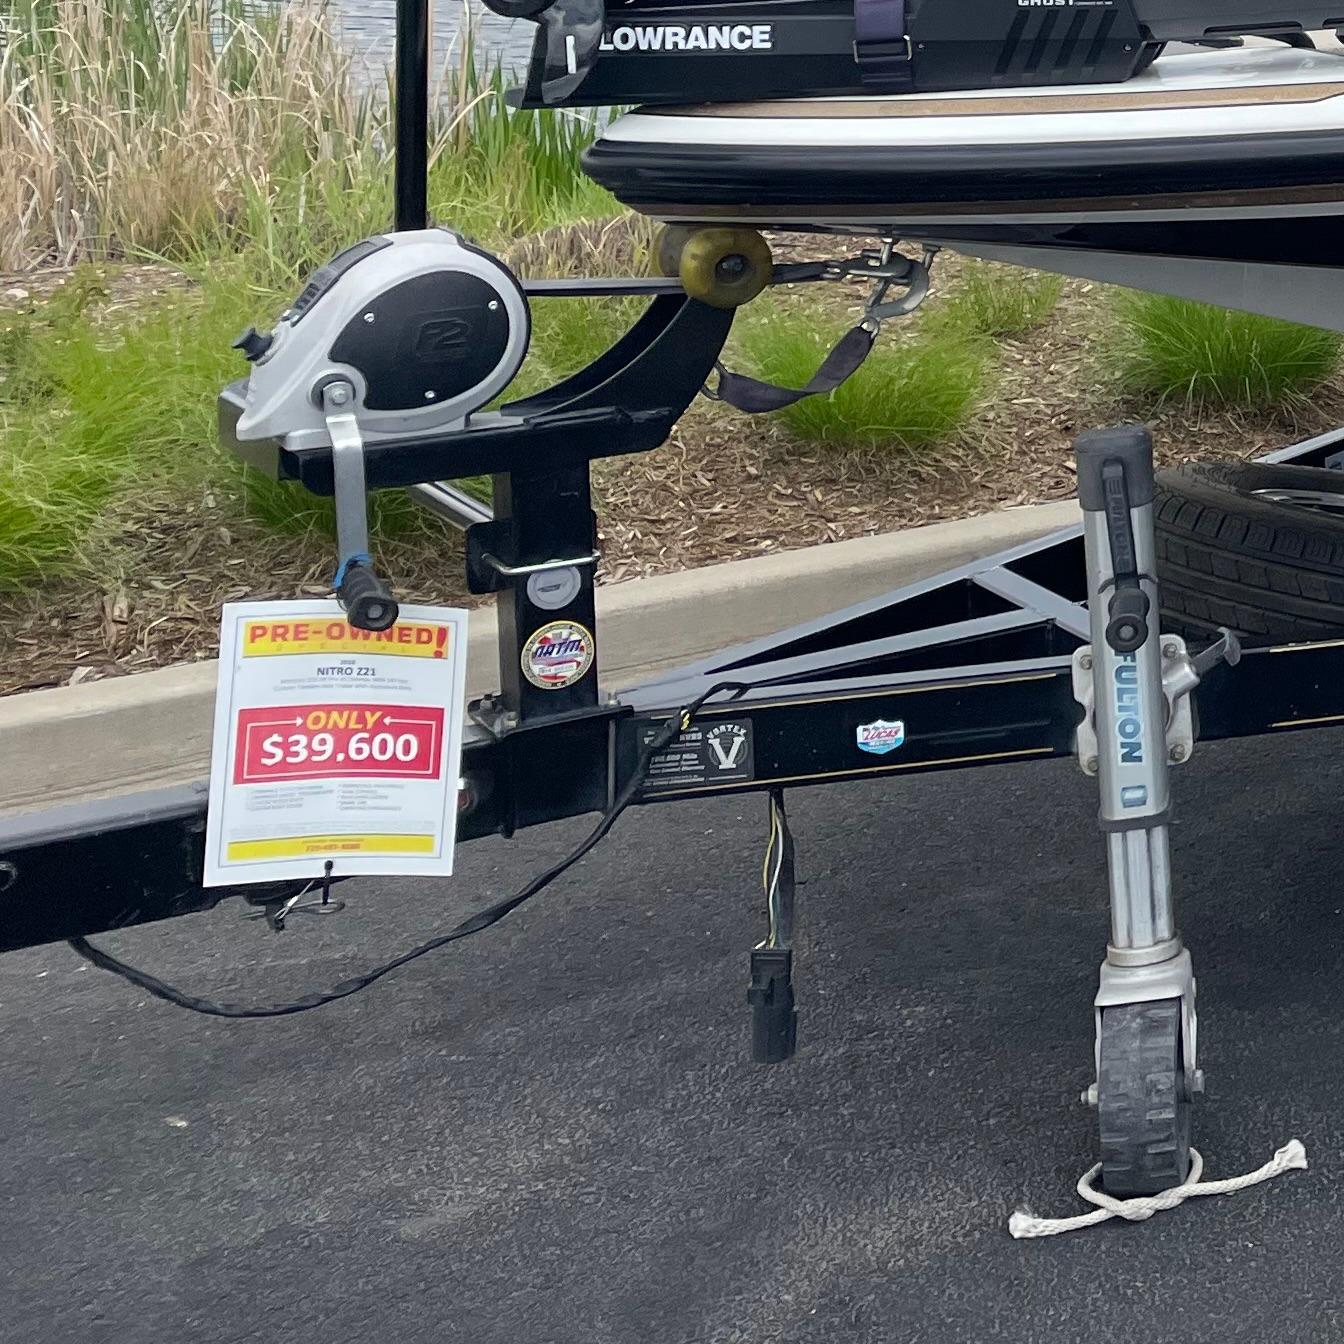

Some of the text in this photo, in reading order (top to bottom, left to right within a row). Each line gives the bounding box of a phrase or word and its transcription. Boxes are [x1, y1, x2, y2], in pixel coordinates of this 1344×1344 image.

[598, 25, 772, 51] LOWRANCE
[249, 623, 448, 658] PRE-OWNED!
[316, 666, 377, 677] NITRO Z21
[1115, 648, 1144, 763] FULTON
[305, 710, 385, 732] ONLY
[706, 724, 748, 739] VORTEX
[261, 732, 419, 767] $39,600
